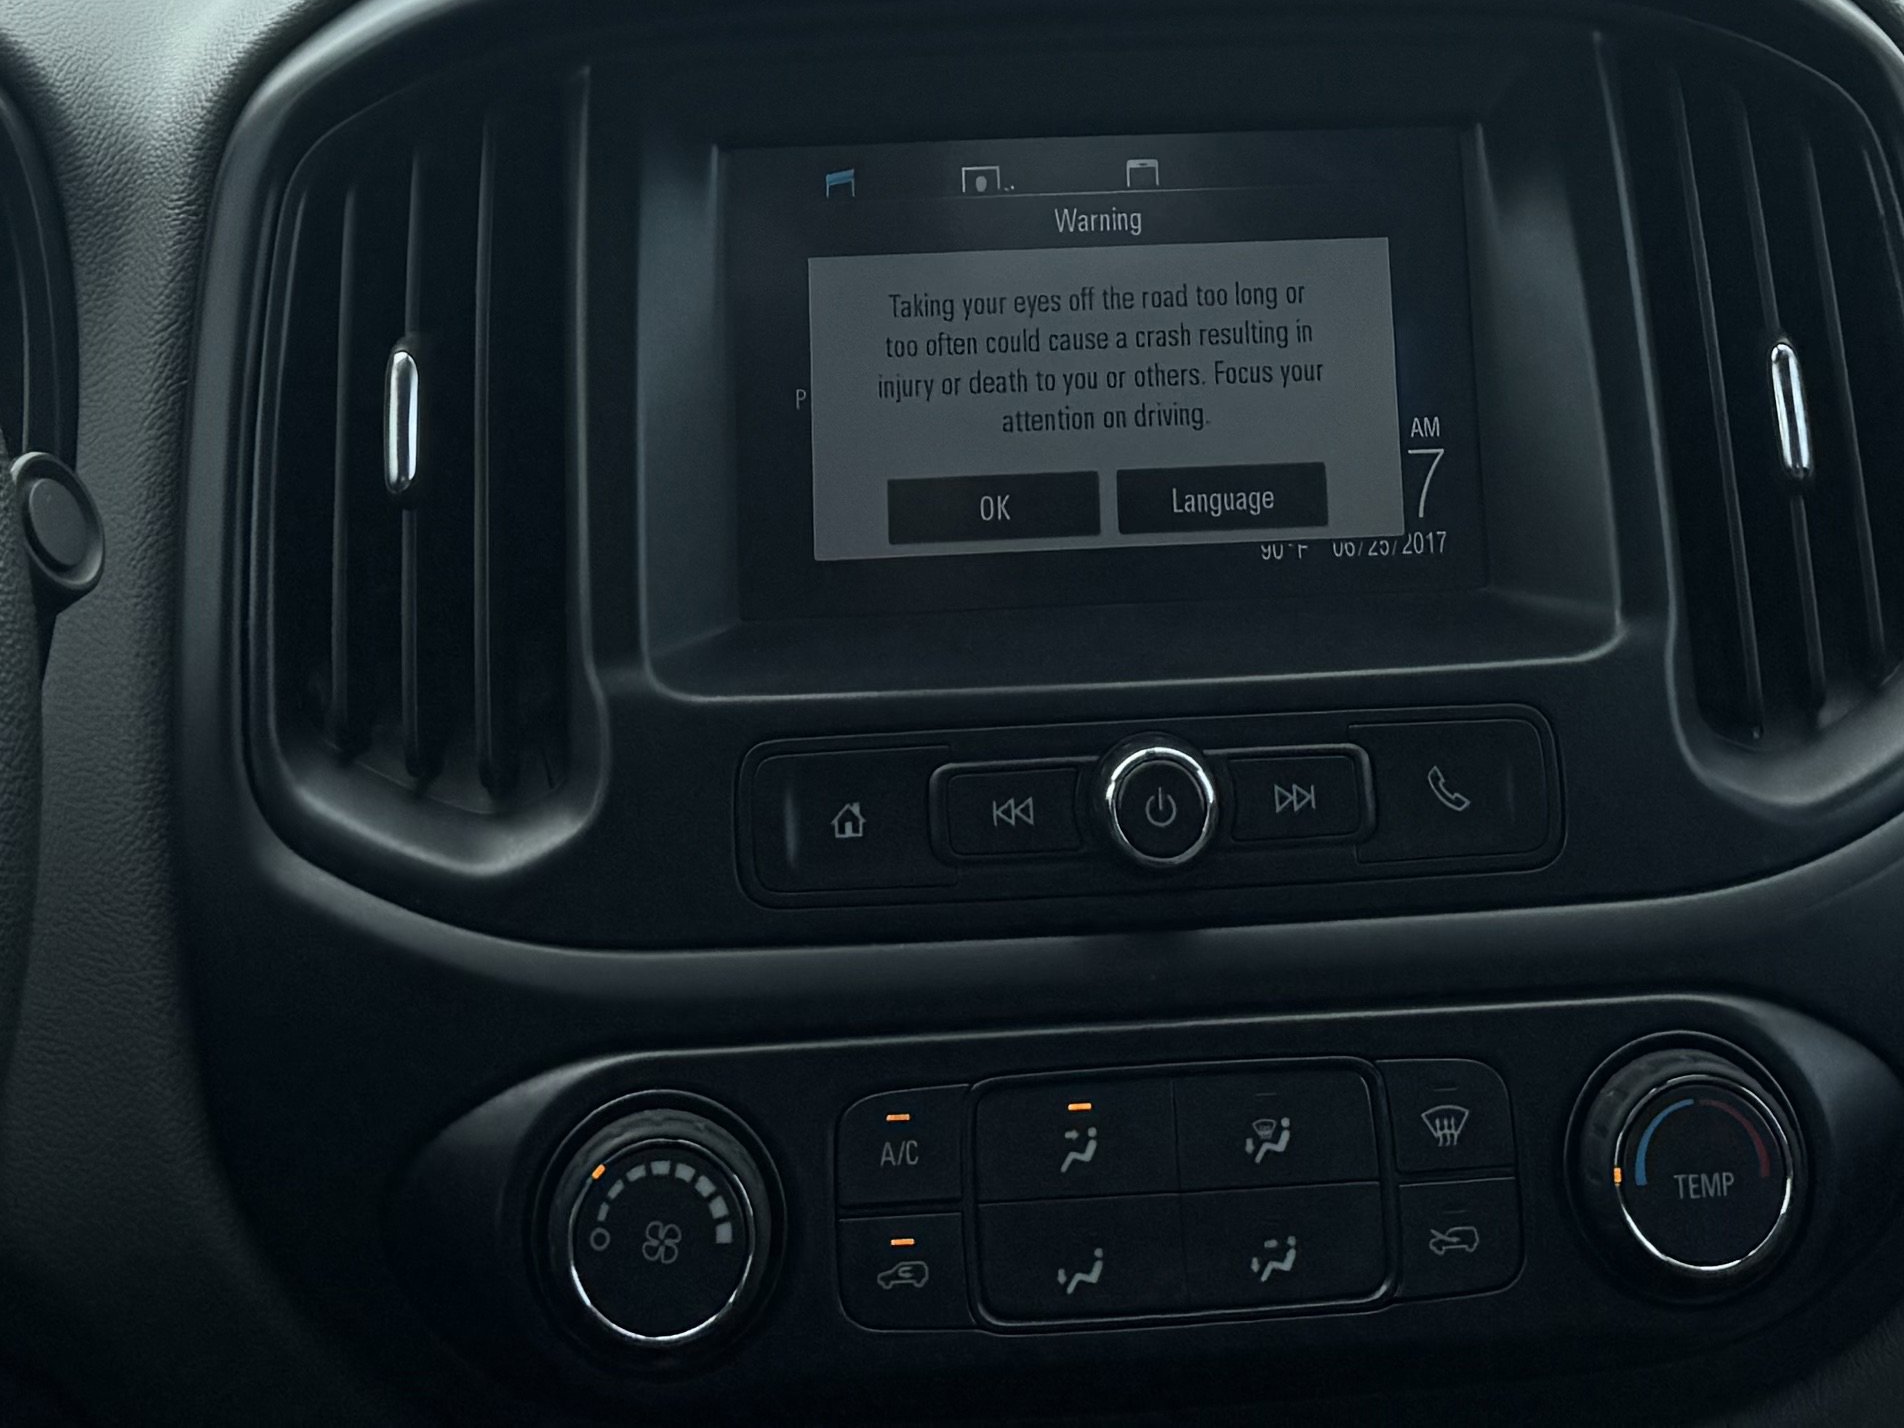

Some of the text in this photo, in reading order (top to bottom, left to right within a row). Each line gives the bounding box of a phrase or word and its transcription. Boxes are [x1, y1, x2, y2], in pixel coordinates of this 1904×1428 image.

[1054, 206, 1143, 236] Warning
[889, 282, 1306, 321] Taking your eyes off the road too long or
[886, 318, 1313, 359] too often could cause a crash resulting in
[878, 360, 1324, 404] injury or death to you or others. Focus your
[1002, 404, 1210, 434] attention on driving.
[1409, 416, 1441, 439] AM
[1407, 447, 1446, 520] 7
[978, 493, 1012, 523] OK
[1171, 486, 1276, 518] Language
[878, 1137, 921, 1170] A/C
[1672, 1170, 1737, 1203] TEMP
